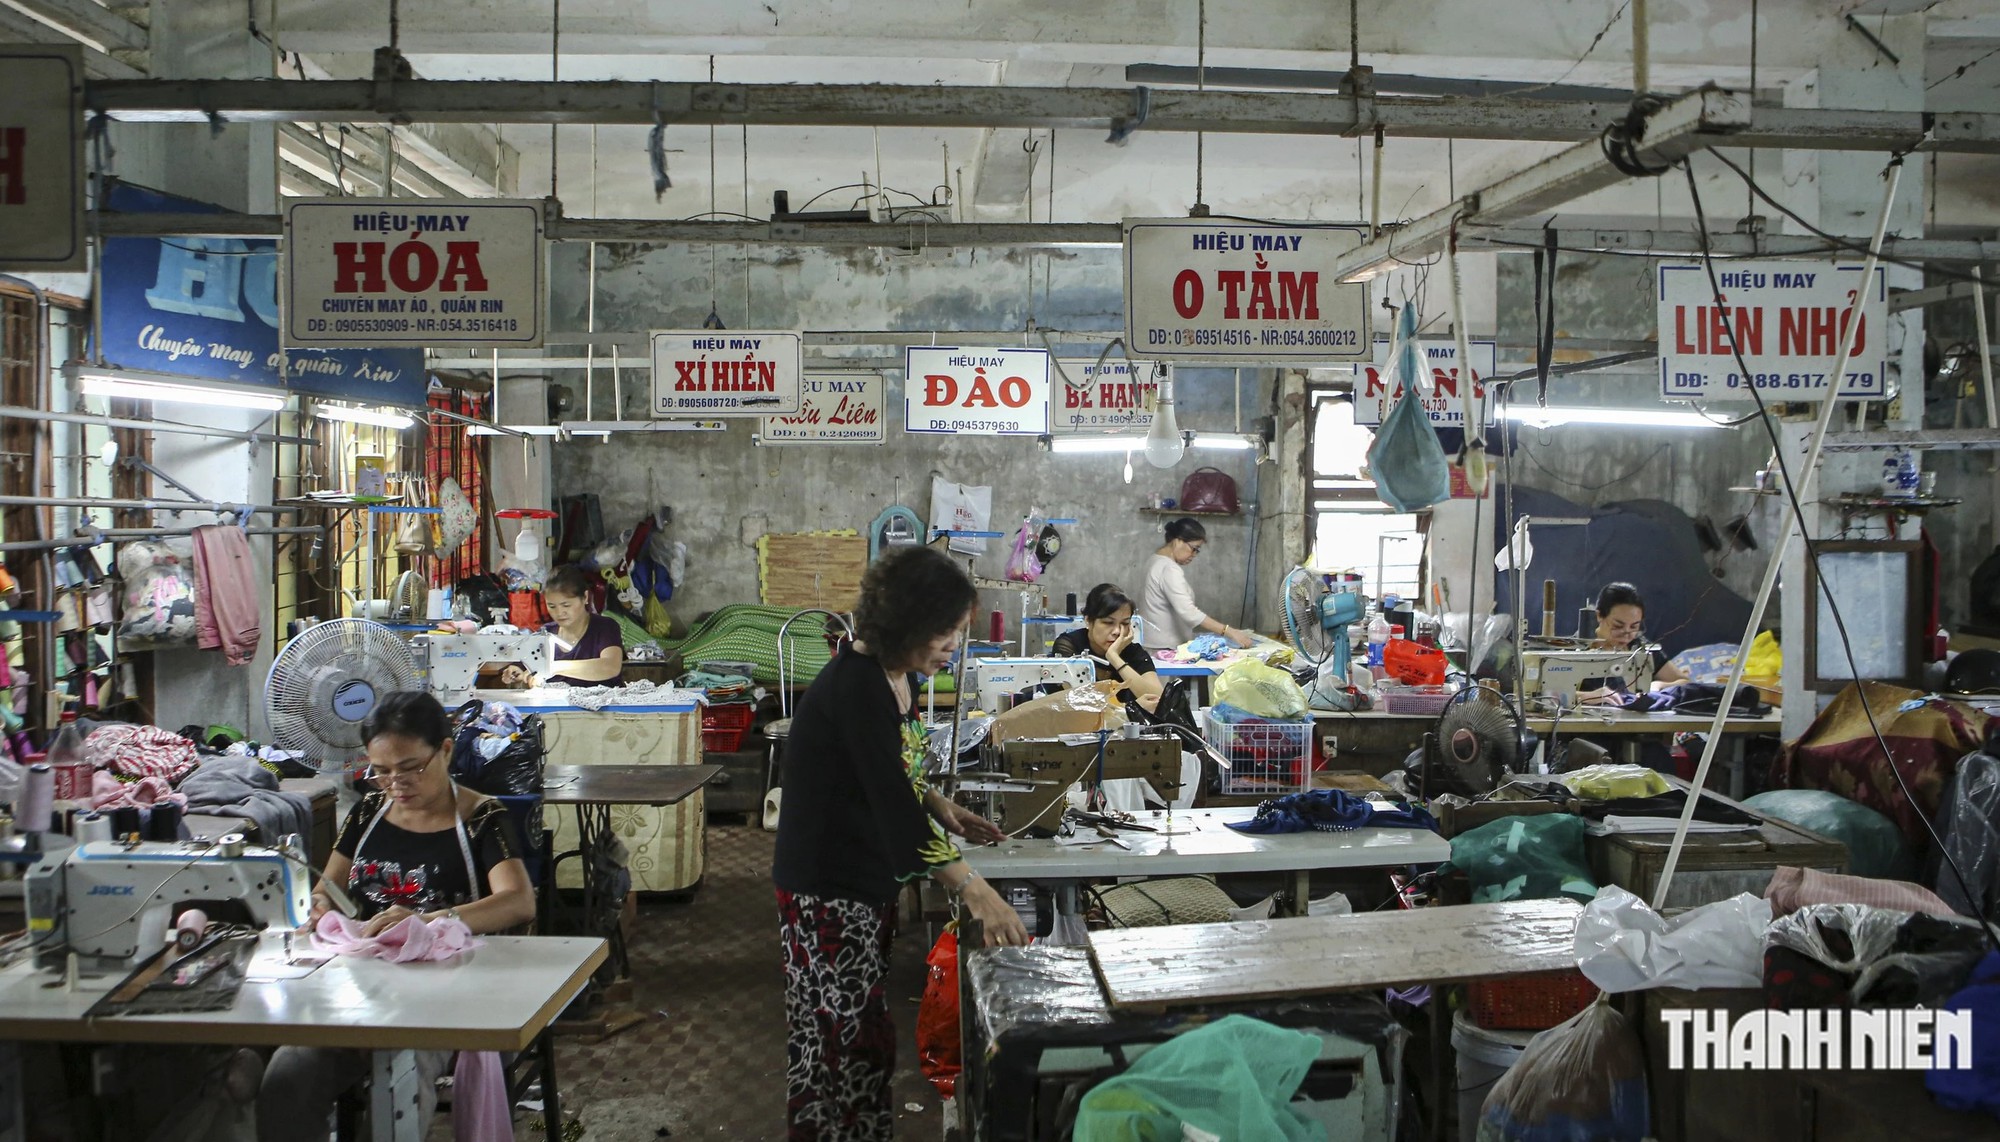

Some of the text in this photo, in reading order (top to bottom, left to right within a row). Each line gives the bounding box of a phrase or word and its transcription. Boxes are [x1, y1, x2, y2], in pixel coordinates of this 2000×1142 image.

[353, 211, 470, 235] HIỆU MAY
[1193, 231, 1302, 254] HIỆU MAY
[333, 231, 488, 293] HÓA
[1173, 253, 1319, 320] O TẰM
[1721, 270, 1816, 292] HIỆU MAY
[322, 295, 374, 313] CHUYÊN
[378, 299, 406, 313] MAY
[480, 299, 503, 313] RIN
[1675, 294, 1763, 356] LIÊN
[692, 337, 761, 352] HIỆU MAY
[1174, 329, 1251, 346] 069514516
[949, 355, 1005, 368] HIỆU MAY
[1428, 348, 1455, 358] MAY
[674, 352, 776, 392] XÍ HIỀN
[1084, 366, 1110, 375] HU
[828, 381, 867, 393] MAY
[923, 367, 1032, 409] ĐÀO
[1099, 383, 1158, 413] HẠN
[827, 394, 877, 425] Liên
